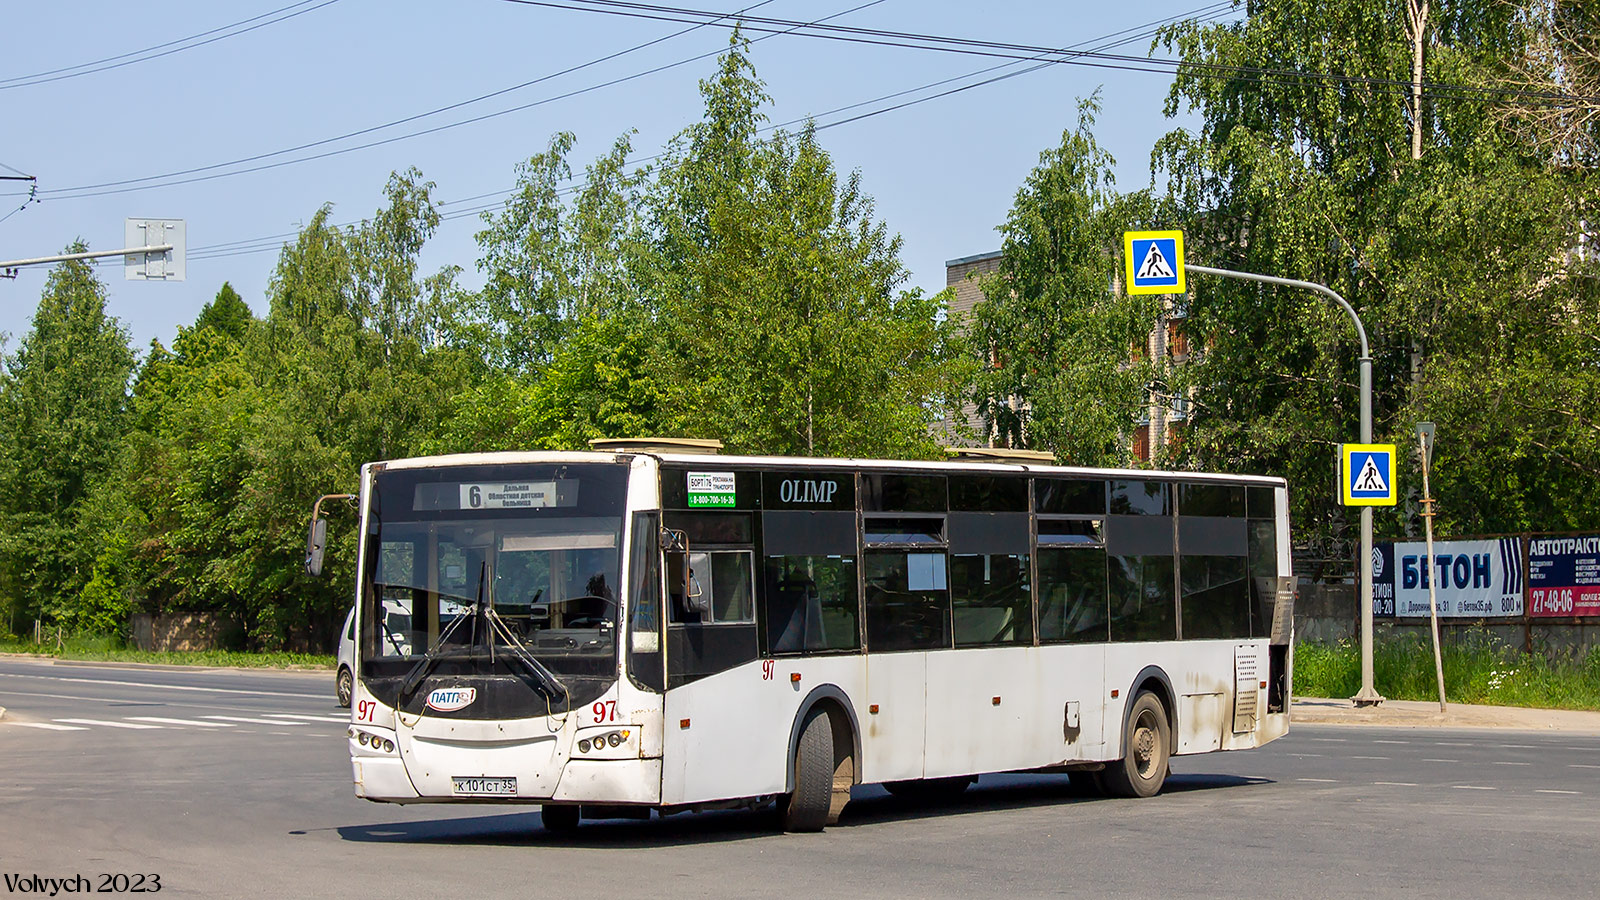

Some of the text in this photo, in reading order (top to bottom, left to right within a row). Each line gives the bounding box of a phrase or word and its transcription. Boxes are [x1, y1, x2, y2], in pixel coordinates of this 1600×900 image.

[469, 486, 481, 508] 6
[780, 479, 838, 503] OLIMP
[1402, 553, 1491, 590] БЕТОН
[1442, 600, 1450, 612] 31
[1501, 597, 1514, 612] 800
[1532, 588, 1573, 613] 27-48-06
[762, 660, 774, 680] 97
[431, 691, 460, 703] ПАТП
[358, 700, 376, 723] 97
[593, 700, 617, 723] 97
